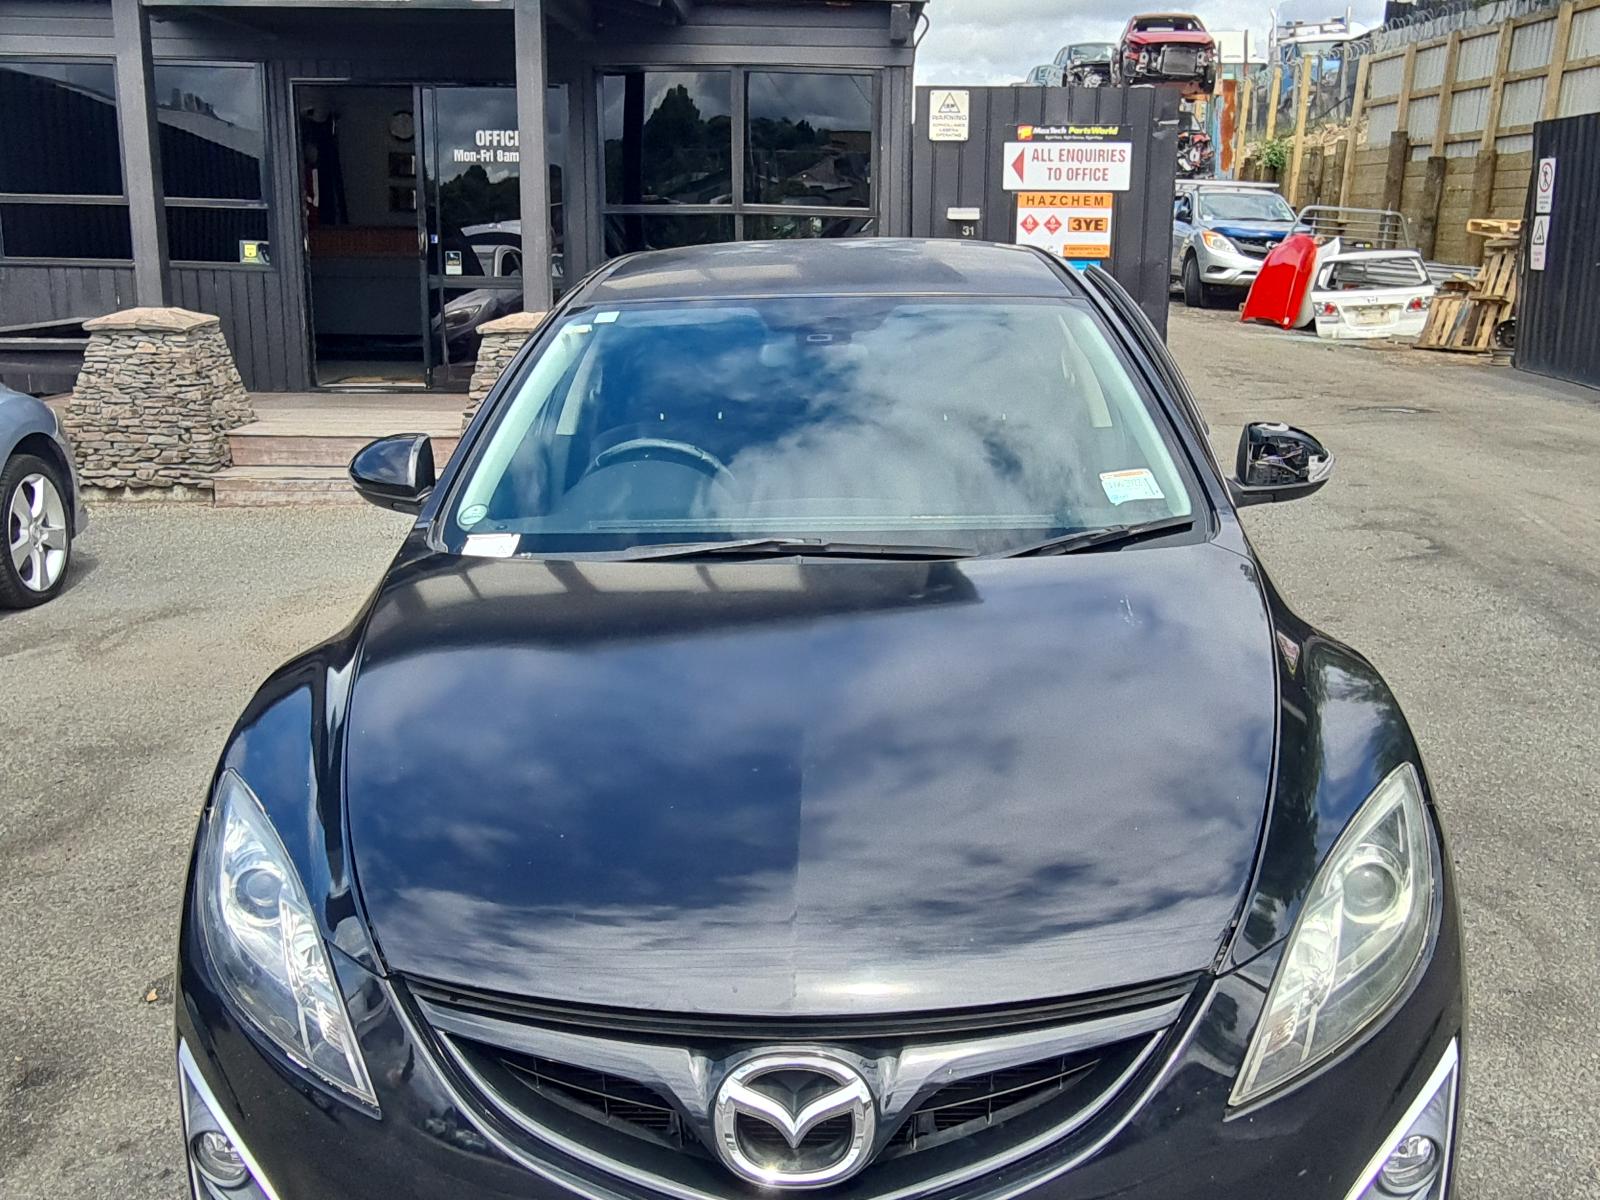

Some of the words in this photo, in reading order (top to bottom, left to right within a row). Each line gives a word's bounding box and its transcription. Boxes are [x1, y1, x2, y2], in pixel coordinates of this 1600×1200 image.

[1068, 126, 1119, 136] PartsWorld
[454, 149, 494, 162] Mon-Fri
[1031, 148, 1054, 162] ALL
[1058, 148, 1126, 164] ENQUIRIES
[1047, 167, 1062, 181] TO
[1066, 167, 1109, 181] OFFICE
[1026, 195, 1104, 206] HAZCHEM
[962, 225, 975, 236] 31
[1072, 218, 1104, 231] 3YE
